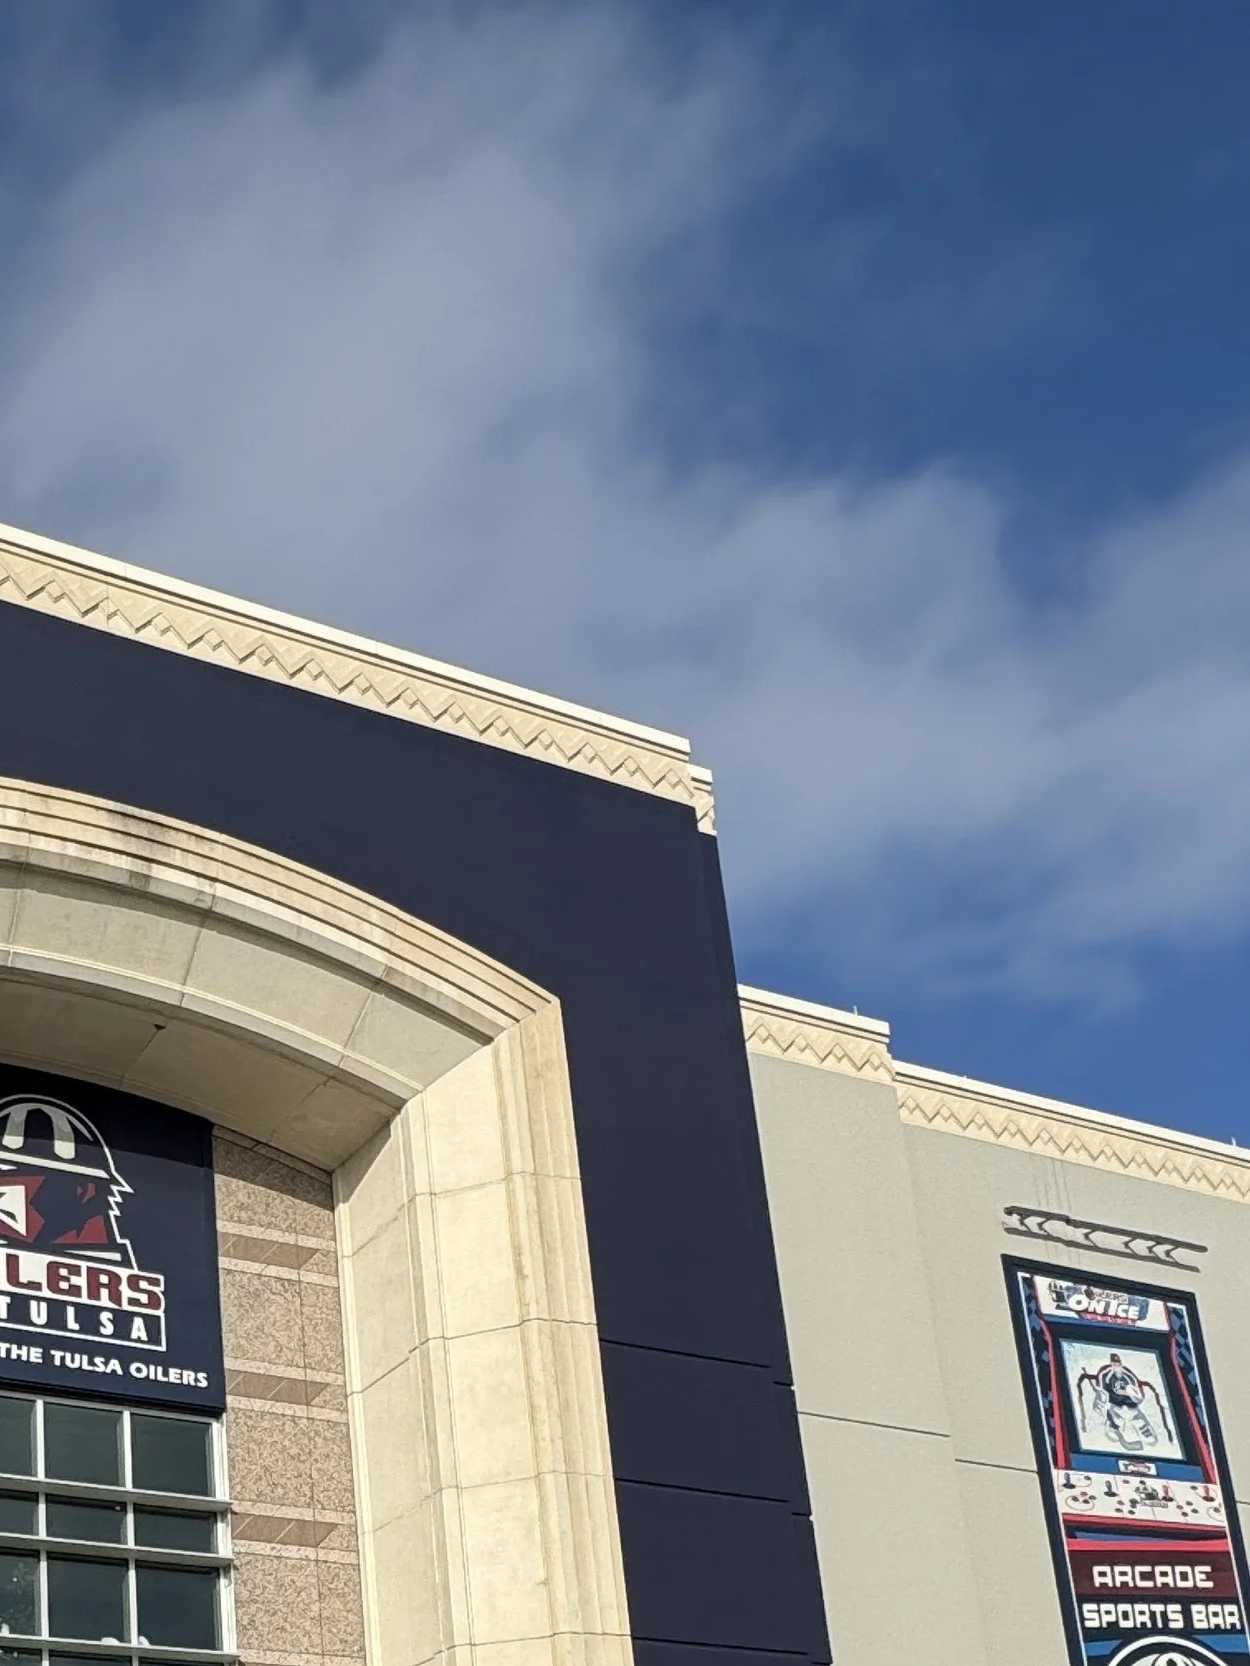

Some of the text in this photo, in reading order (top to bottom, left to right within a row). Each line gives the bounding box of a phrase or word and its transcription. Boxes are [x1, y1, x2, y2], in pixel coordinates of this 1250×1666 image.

[50, 1350, 123, 1376] TULSA
[129, 1362, 209, 1387] OILERS
[1092, 1565, 1214, 1588] ARCADE
[1082, 1603, 1242, 1629] SPORTS BAR
